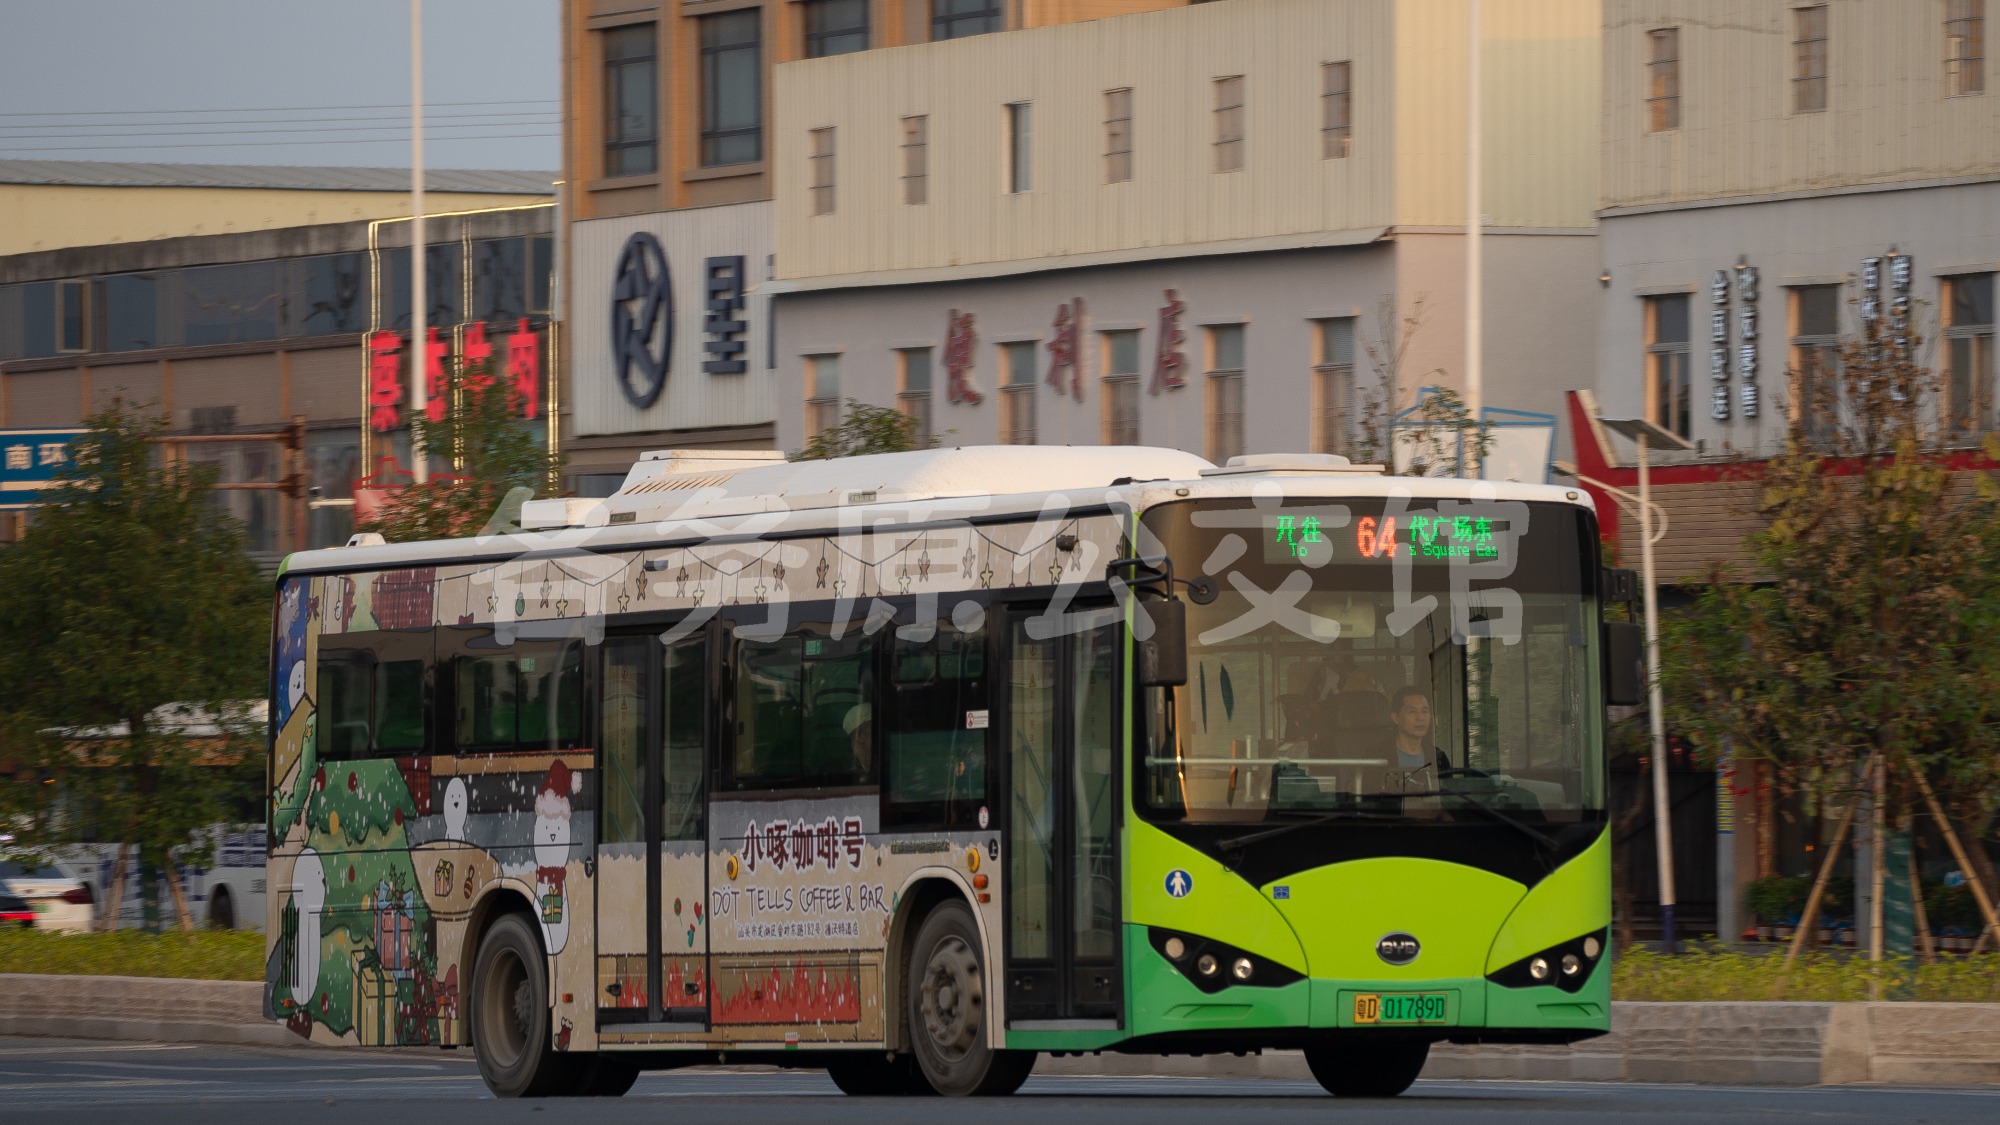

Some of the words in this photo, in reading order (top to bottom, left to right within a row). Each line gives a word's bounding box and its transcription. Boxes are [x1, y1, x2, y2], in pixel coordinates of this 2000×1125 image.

[1276, 516, 1322, 543] 开往
[1357, 515, 1397, 557] 64
[1409, 515, 1493, 543] 代广场东
[1289, 542, 1309, 557] To
[1422, 541, 1471, 559] Square
[742, 820, 865, 872] 小啄咖啡号
[746, 887, 794, 917] TELLS
[800, 886, 843, 915] COFFEE
[845, 885, 856, 912] &
[860, 885, 889, 913] BAR
[1382, 941, 1416, 954] BYD
